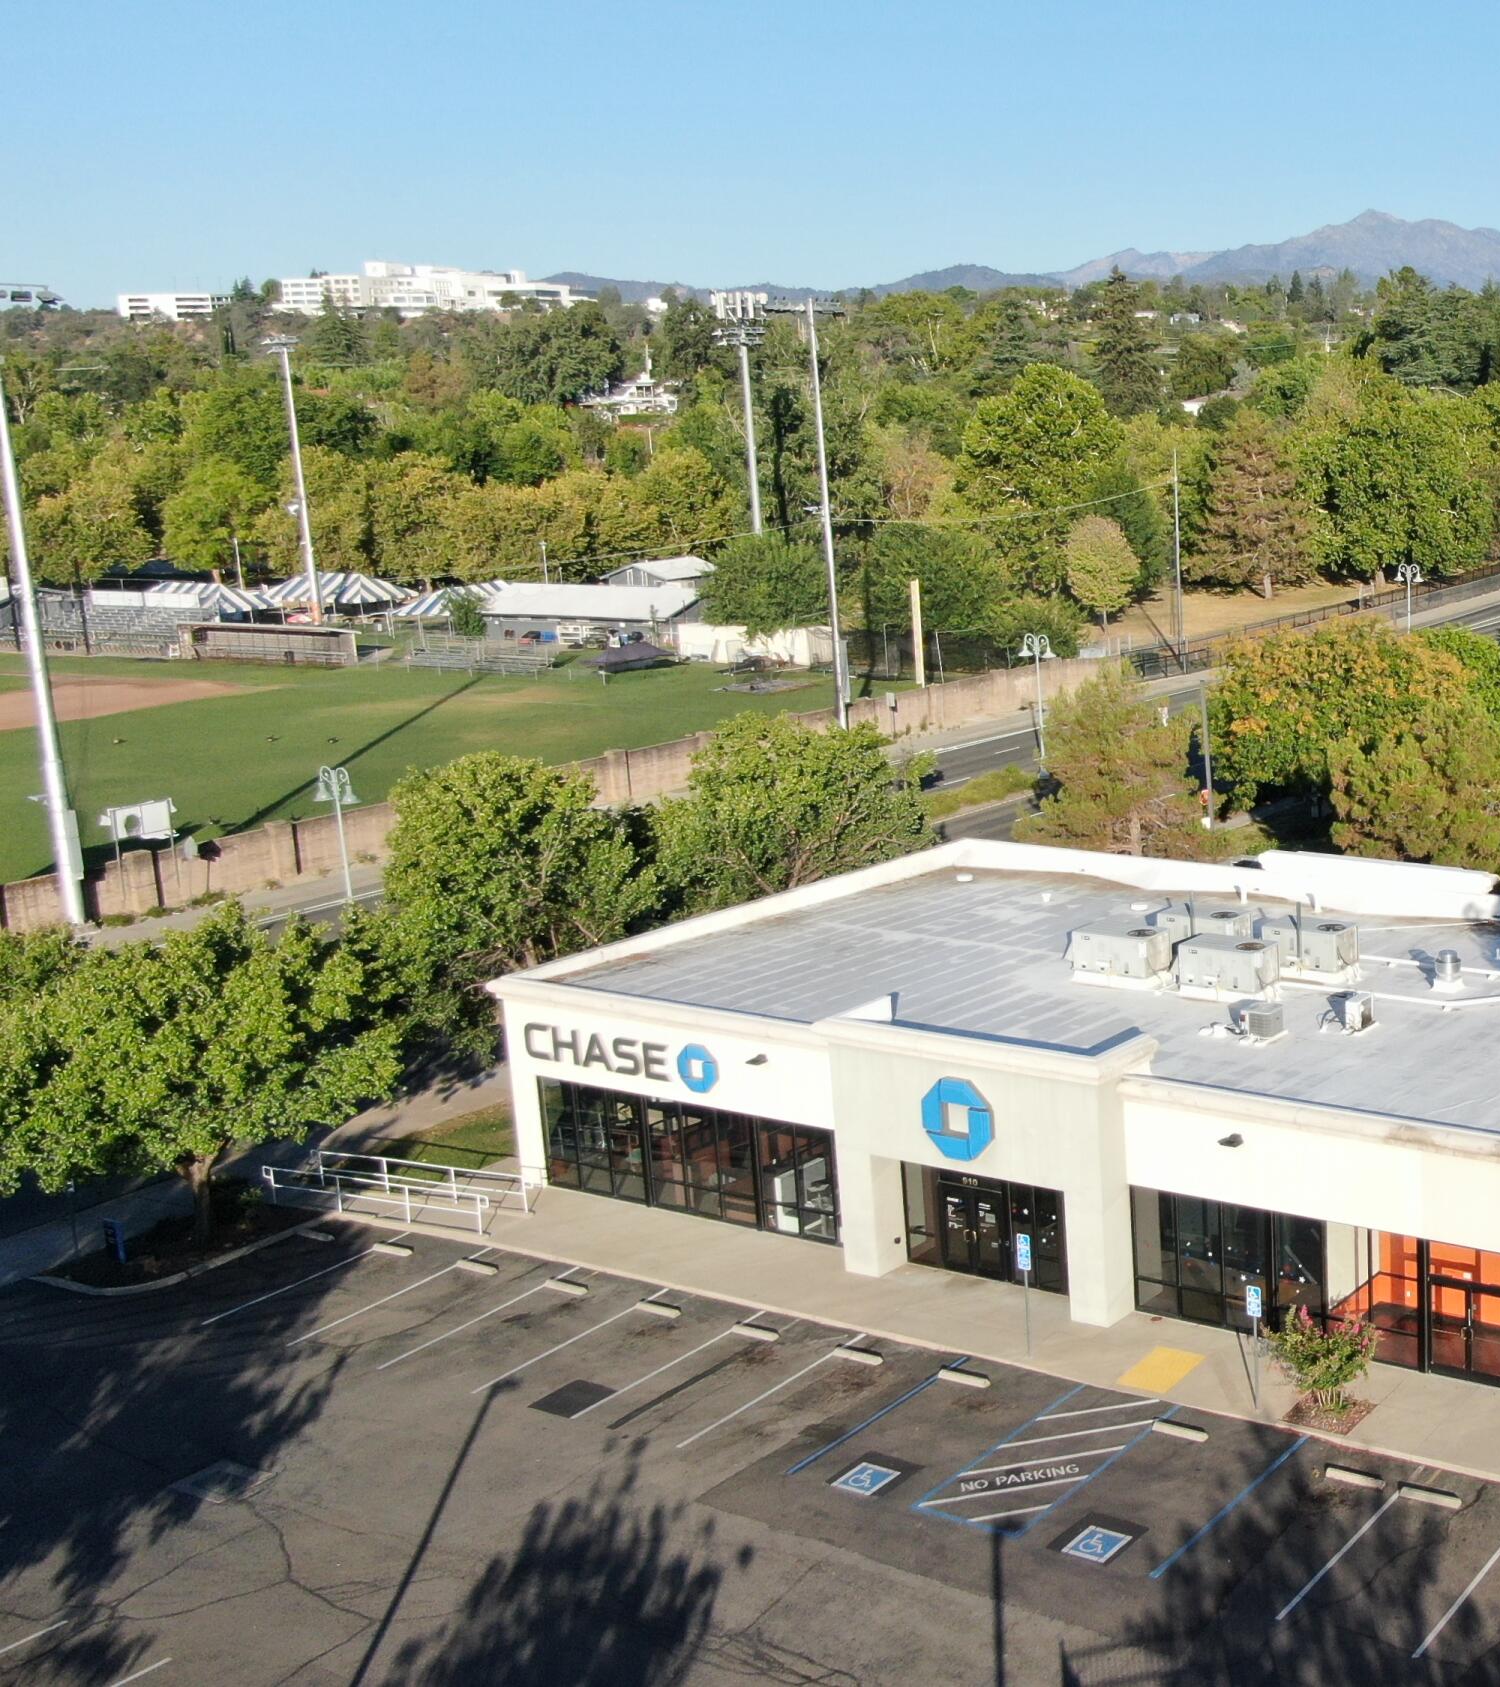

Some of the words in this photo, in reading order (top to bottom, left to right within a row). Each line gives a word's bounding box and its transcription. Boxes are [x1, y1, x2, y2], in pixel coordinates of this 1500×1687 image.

[524, 1022, 673, 1082] CHASE
[961, 1480, 988, 1492] NO
[996, 1464, 1080, 1486] PARKING
